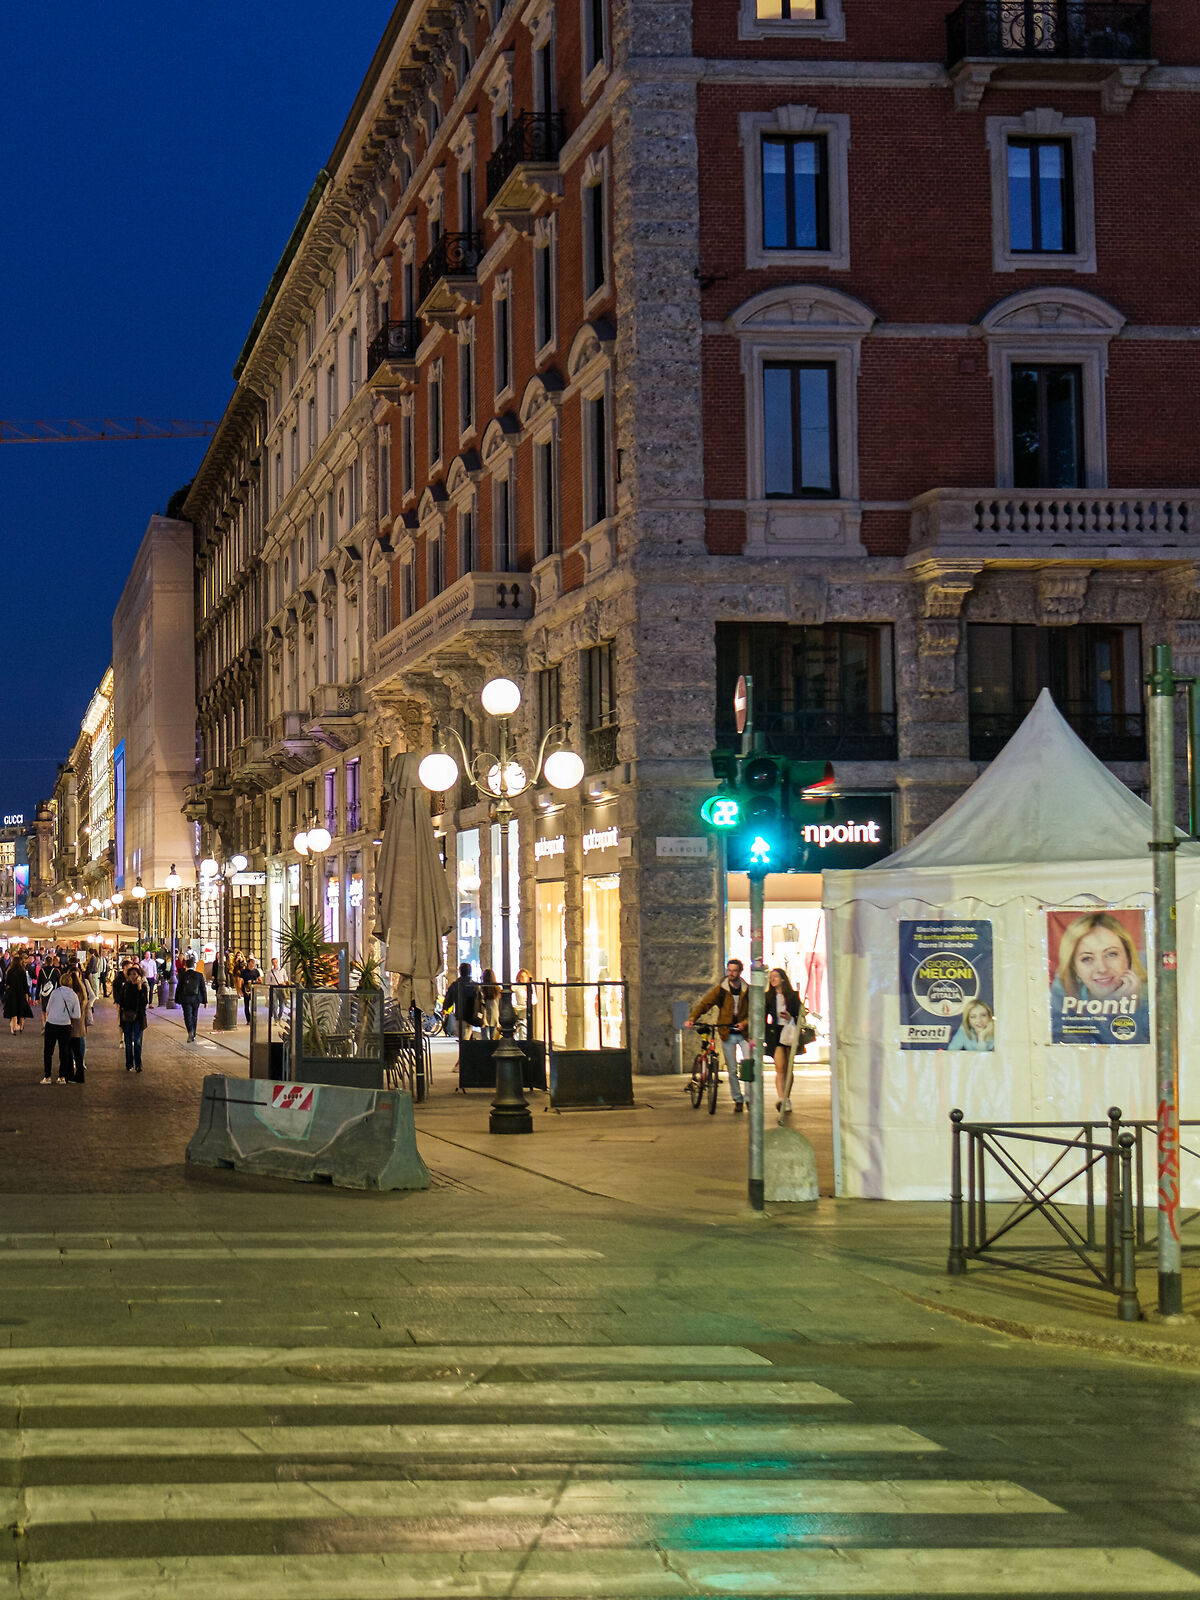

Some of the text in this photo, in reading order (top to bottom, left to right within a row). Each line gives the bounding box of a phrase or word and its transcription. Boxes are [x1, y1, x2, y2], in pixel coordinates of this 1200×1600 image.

[712, 801, 740, 825] 22
[3, 814, 24, 825] GUCCI
[801, 820, 881, 848] npoint
[925, 959, 965, 969] GIORGIA
[920, 968, 973, 979] MELONI
[1061, 994, 1137, 1015] Pronti
[907, 1026, 947, 1038] Pronti
